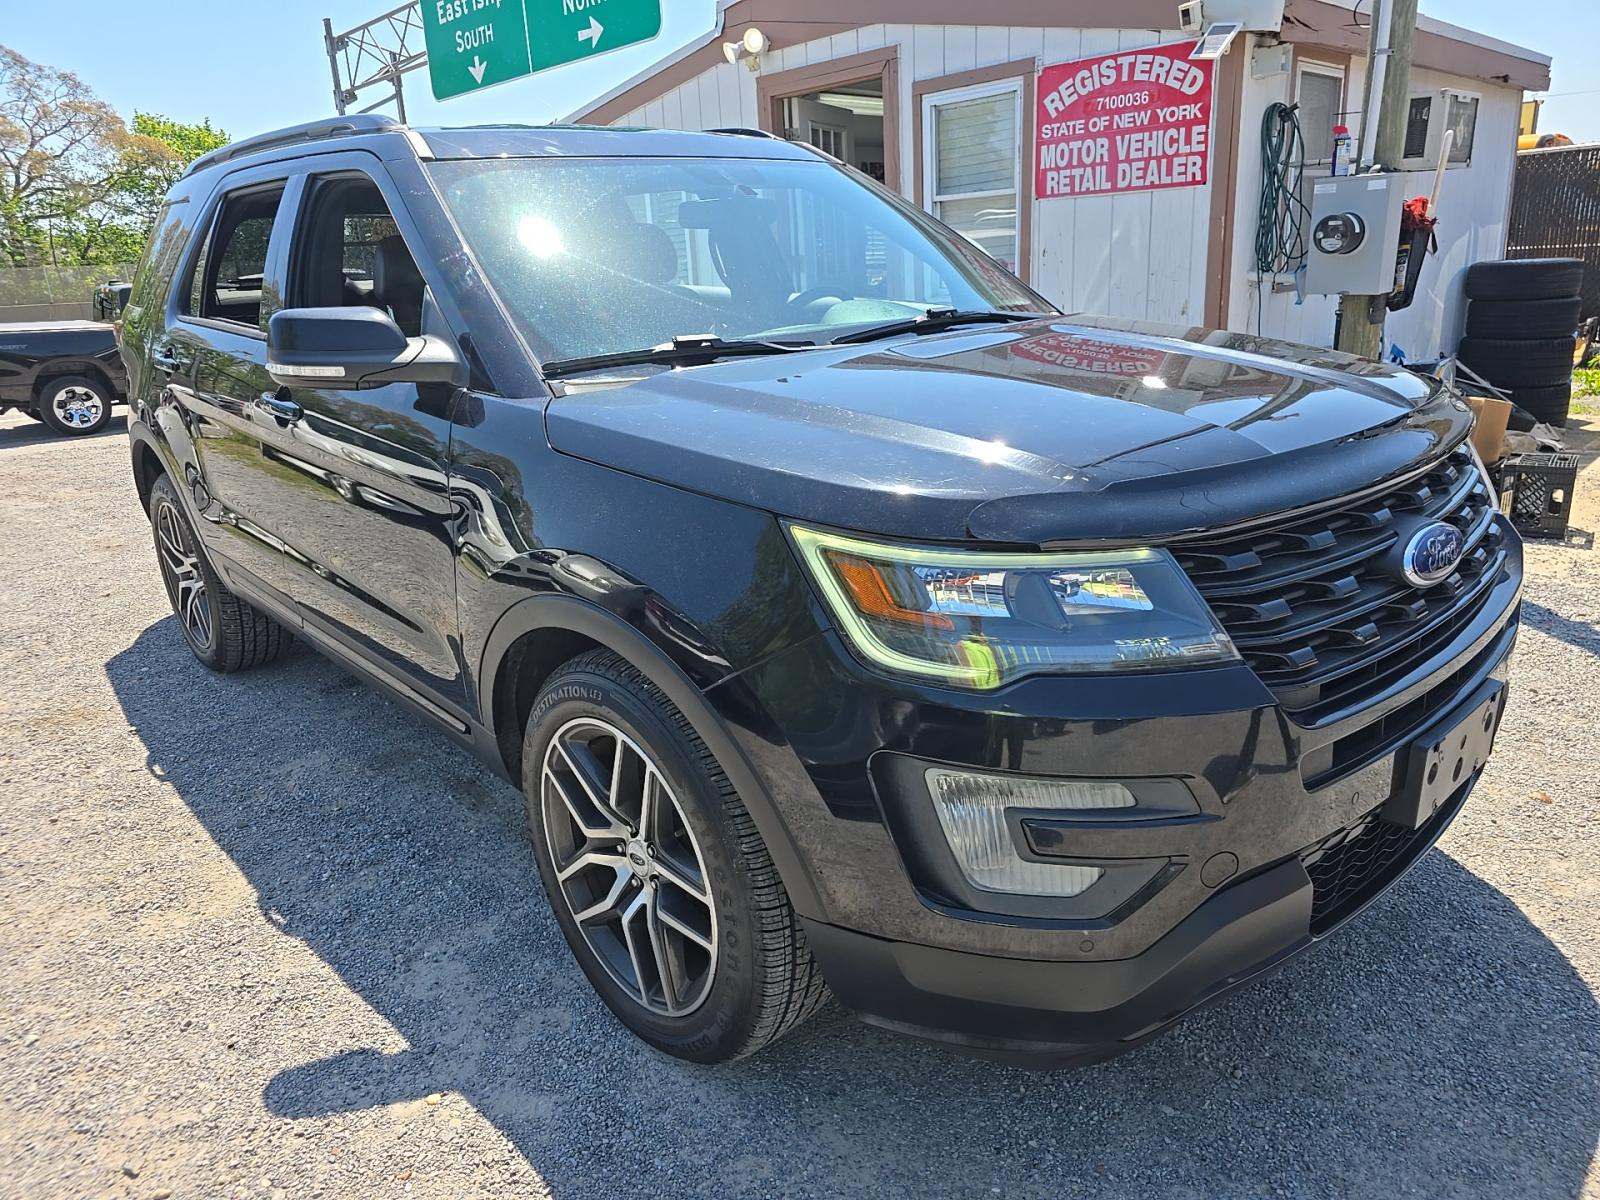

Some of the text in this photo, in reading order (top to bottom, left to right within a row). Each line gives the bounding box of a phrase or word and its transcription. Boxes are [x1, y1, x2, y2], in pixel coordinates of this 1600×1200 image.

[437, 0, 469, 25] East
[455, 23, 494, 53] SOUTH
[1043, 55, 1204, 119] REGISTERED
[1097, 91, 1149, 111] 7100036
[1041, 103, 1203, 139] STATE OF NEW YORK
[1040, 125, 1206, 169] MOTOR VEHICLE
[1046, 155, 1203, 195] RETAIL DEALER
[1424, 533, 1458, 573] Ford
[533, 686, 588, 722] DESTINATION
